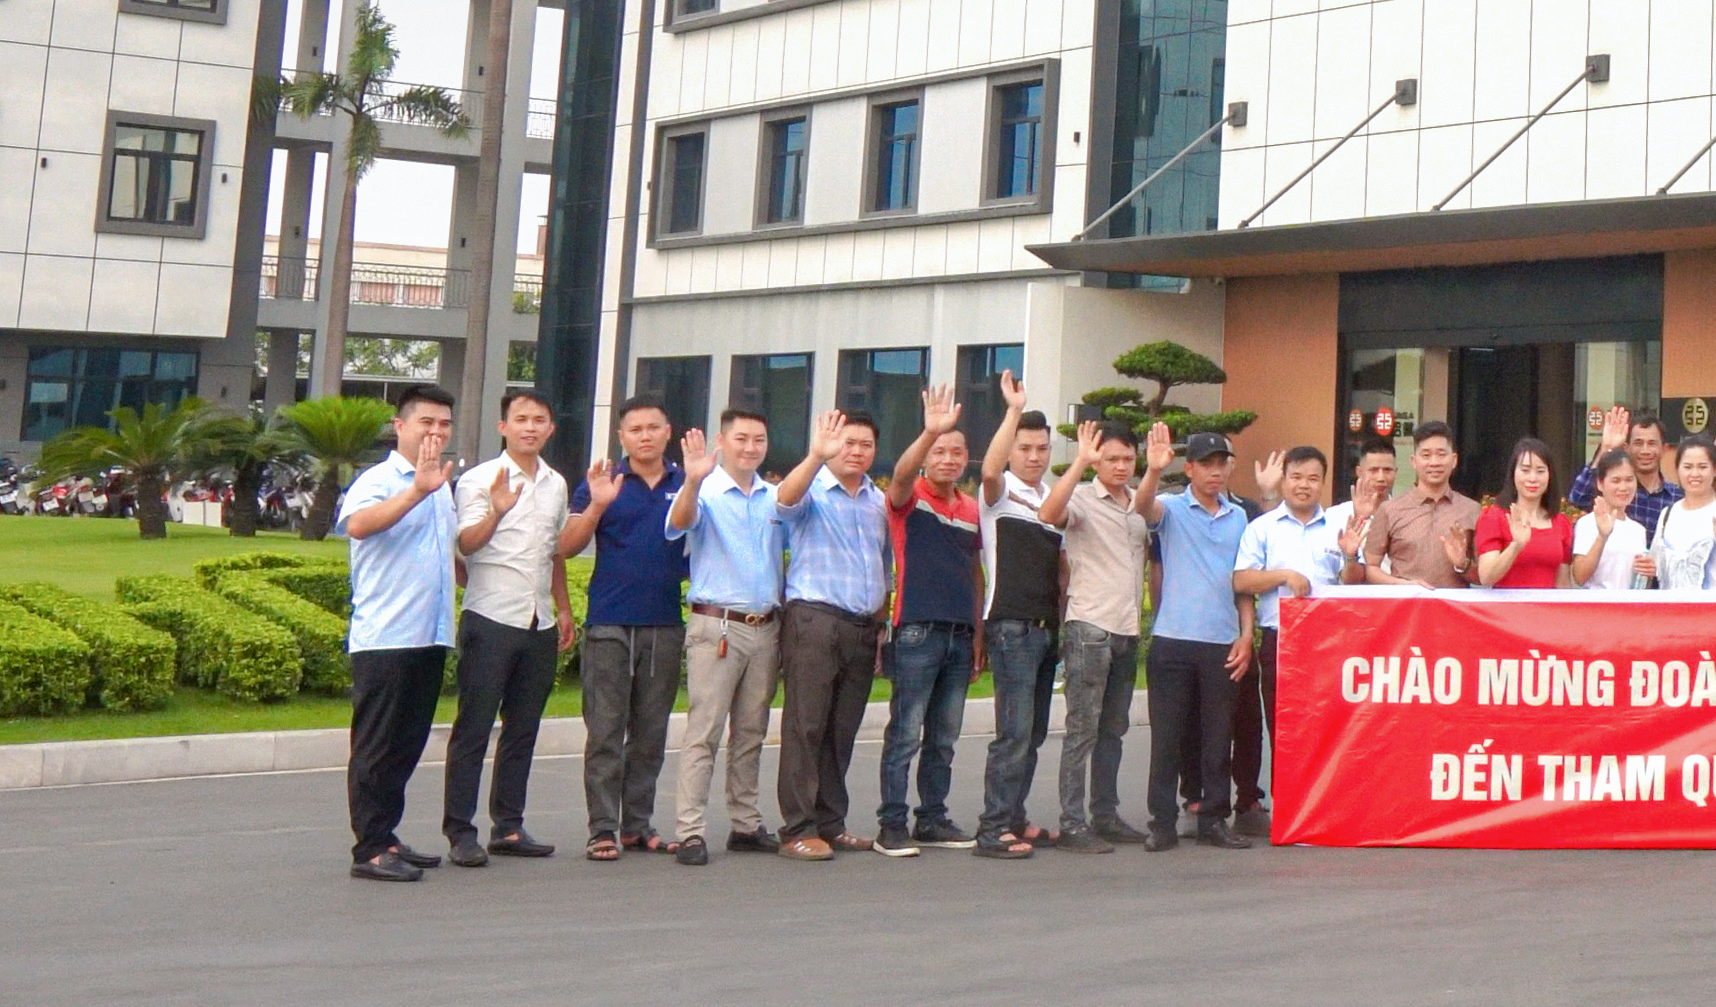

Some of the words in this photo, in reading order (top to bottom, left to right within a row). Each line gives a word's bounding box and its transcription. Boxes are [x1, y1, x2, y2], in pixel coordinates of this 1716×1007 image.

[1342, 646, 1462, 705] CHÀO
[1478, 649, 1615, 707] MỪNG
[1430, 738, 1523, 801] ĐẾN
[1537, 754, 1667, 802] THAM
